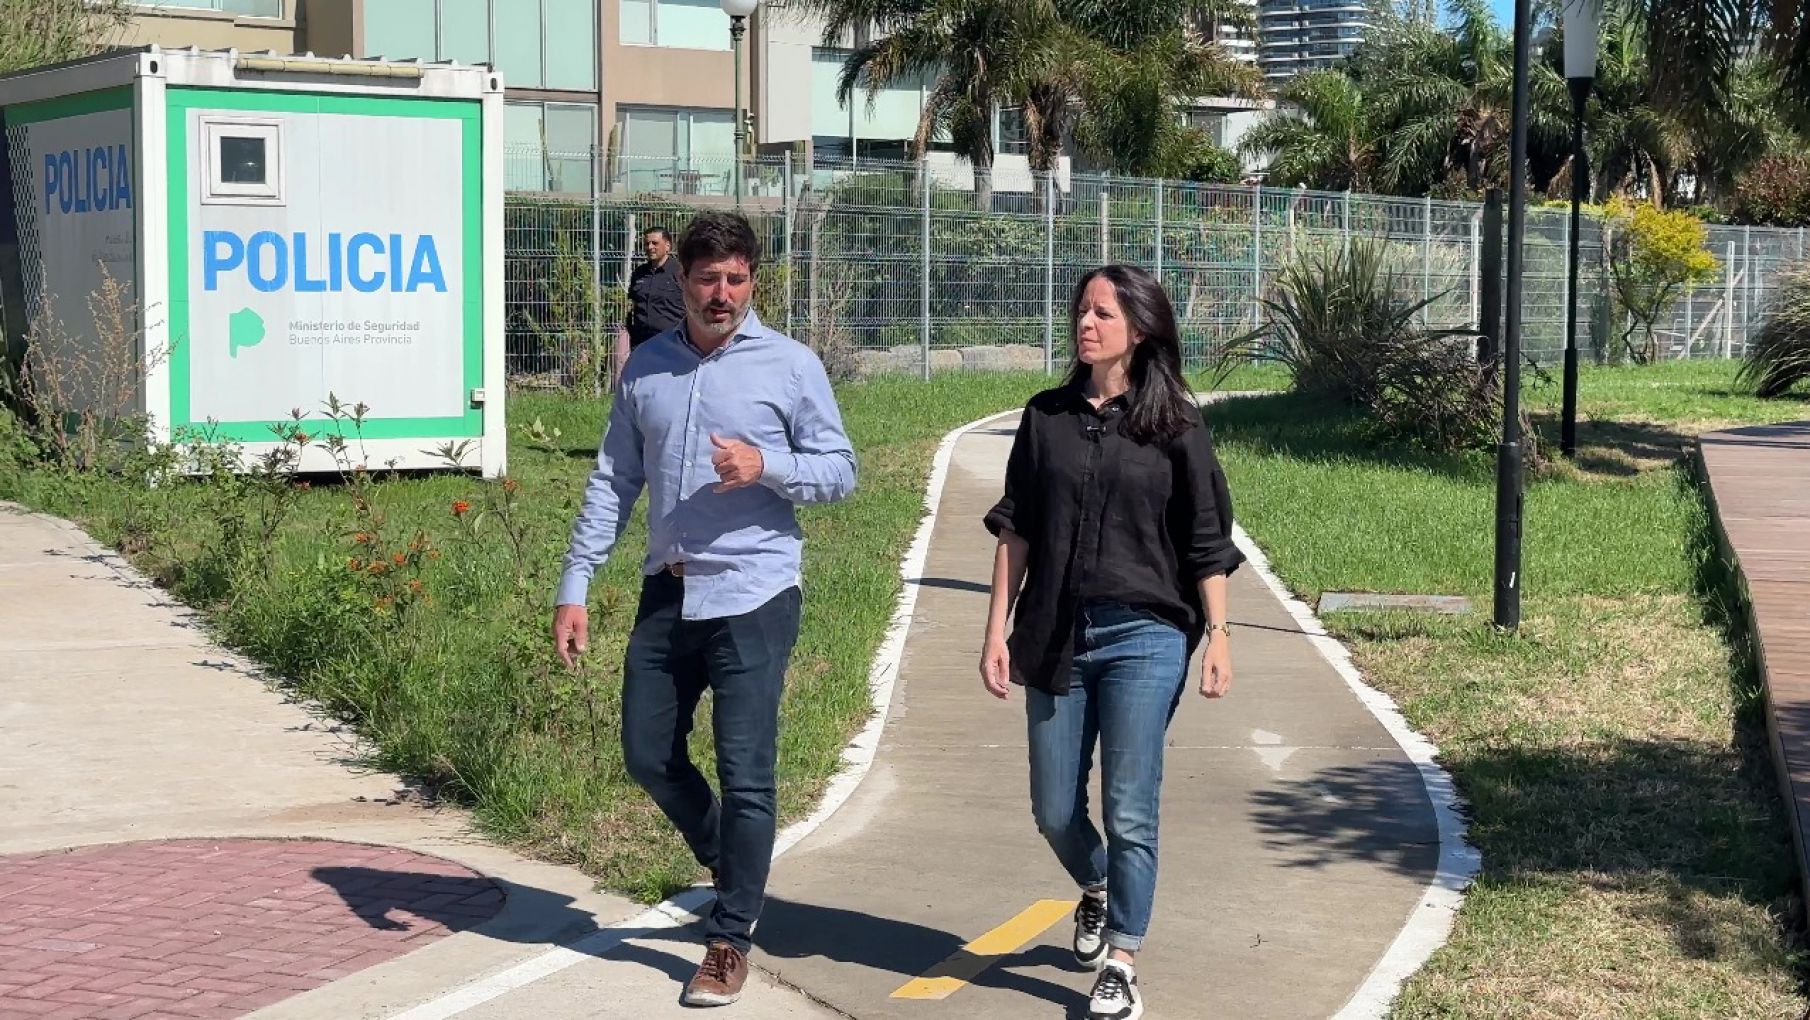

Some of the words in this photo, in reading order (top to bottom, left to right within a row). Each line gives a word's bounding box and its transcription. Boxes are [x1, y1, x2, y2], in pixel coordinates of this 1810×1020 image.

[44, 144, 133, 215] POLICIA
[203, 230, 448, 293] POLICIA
[289, 320, 345, 332] Ministerio
[347, 320, 361, 332] de
[363, 320, 420, 334] Seguridad
[289, 334, 330, 346] Buenos
[332, 333, 361, 345] Aires
[363, 333, 412, 345] Provincia
